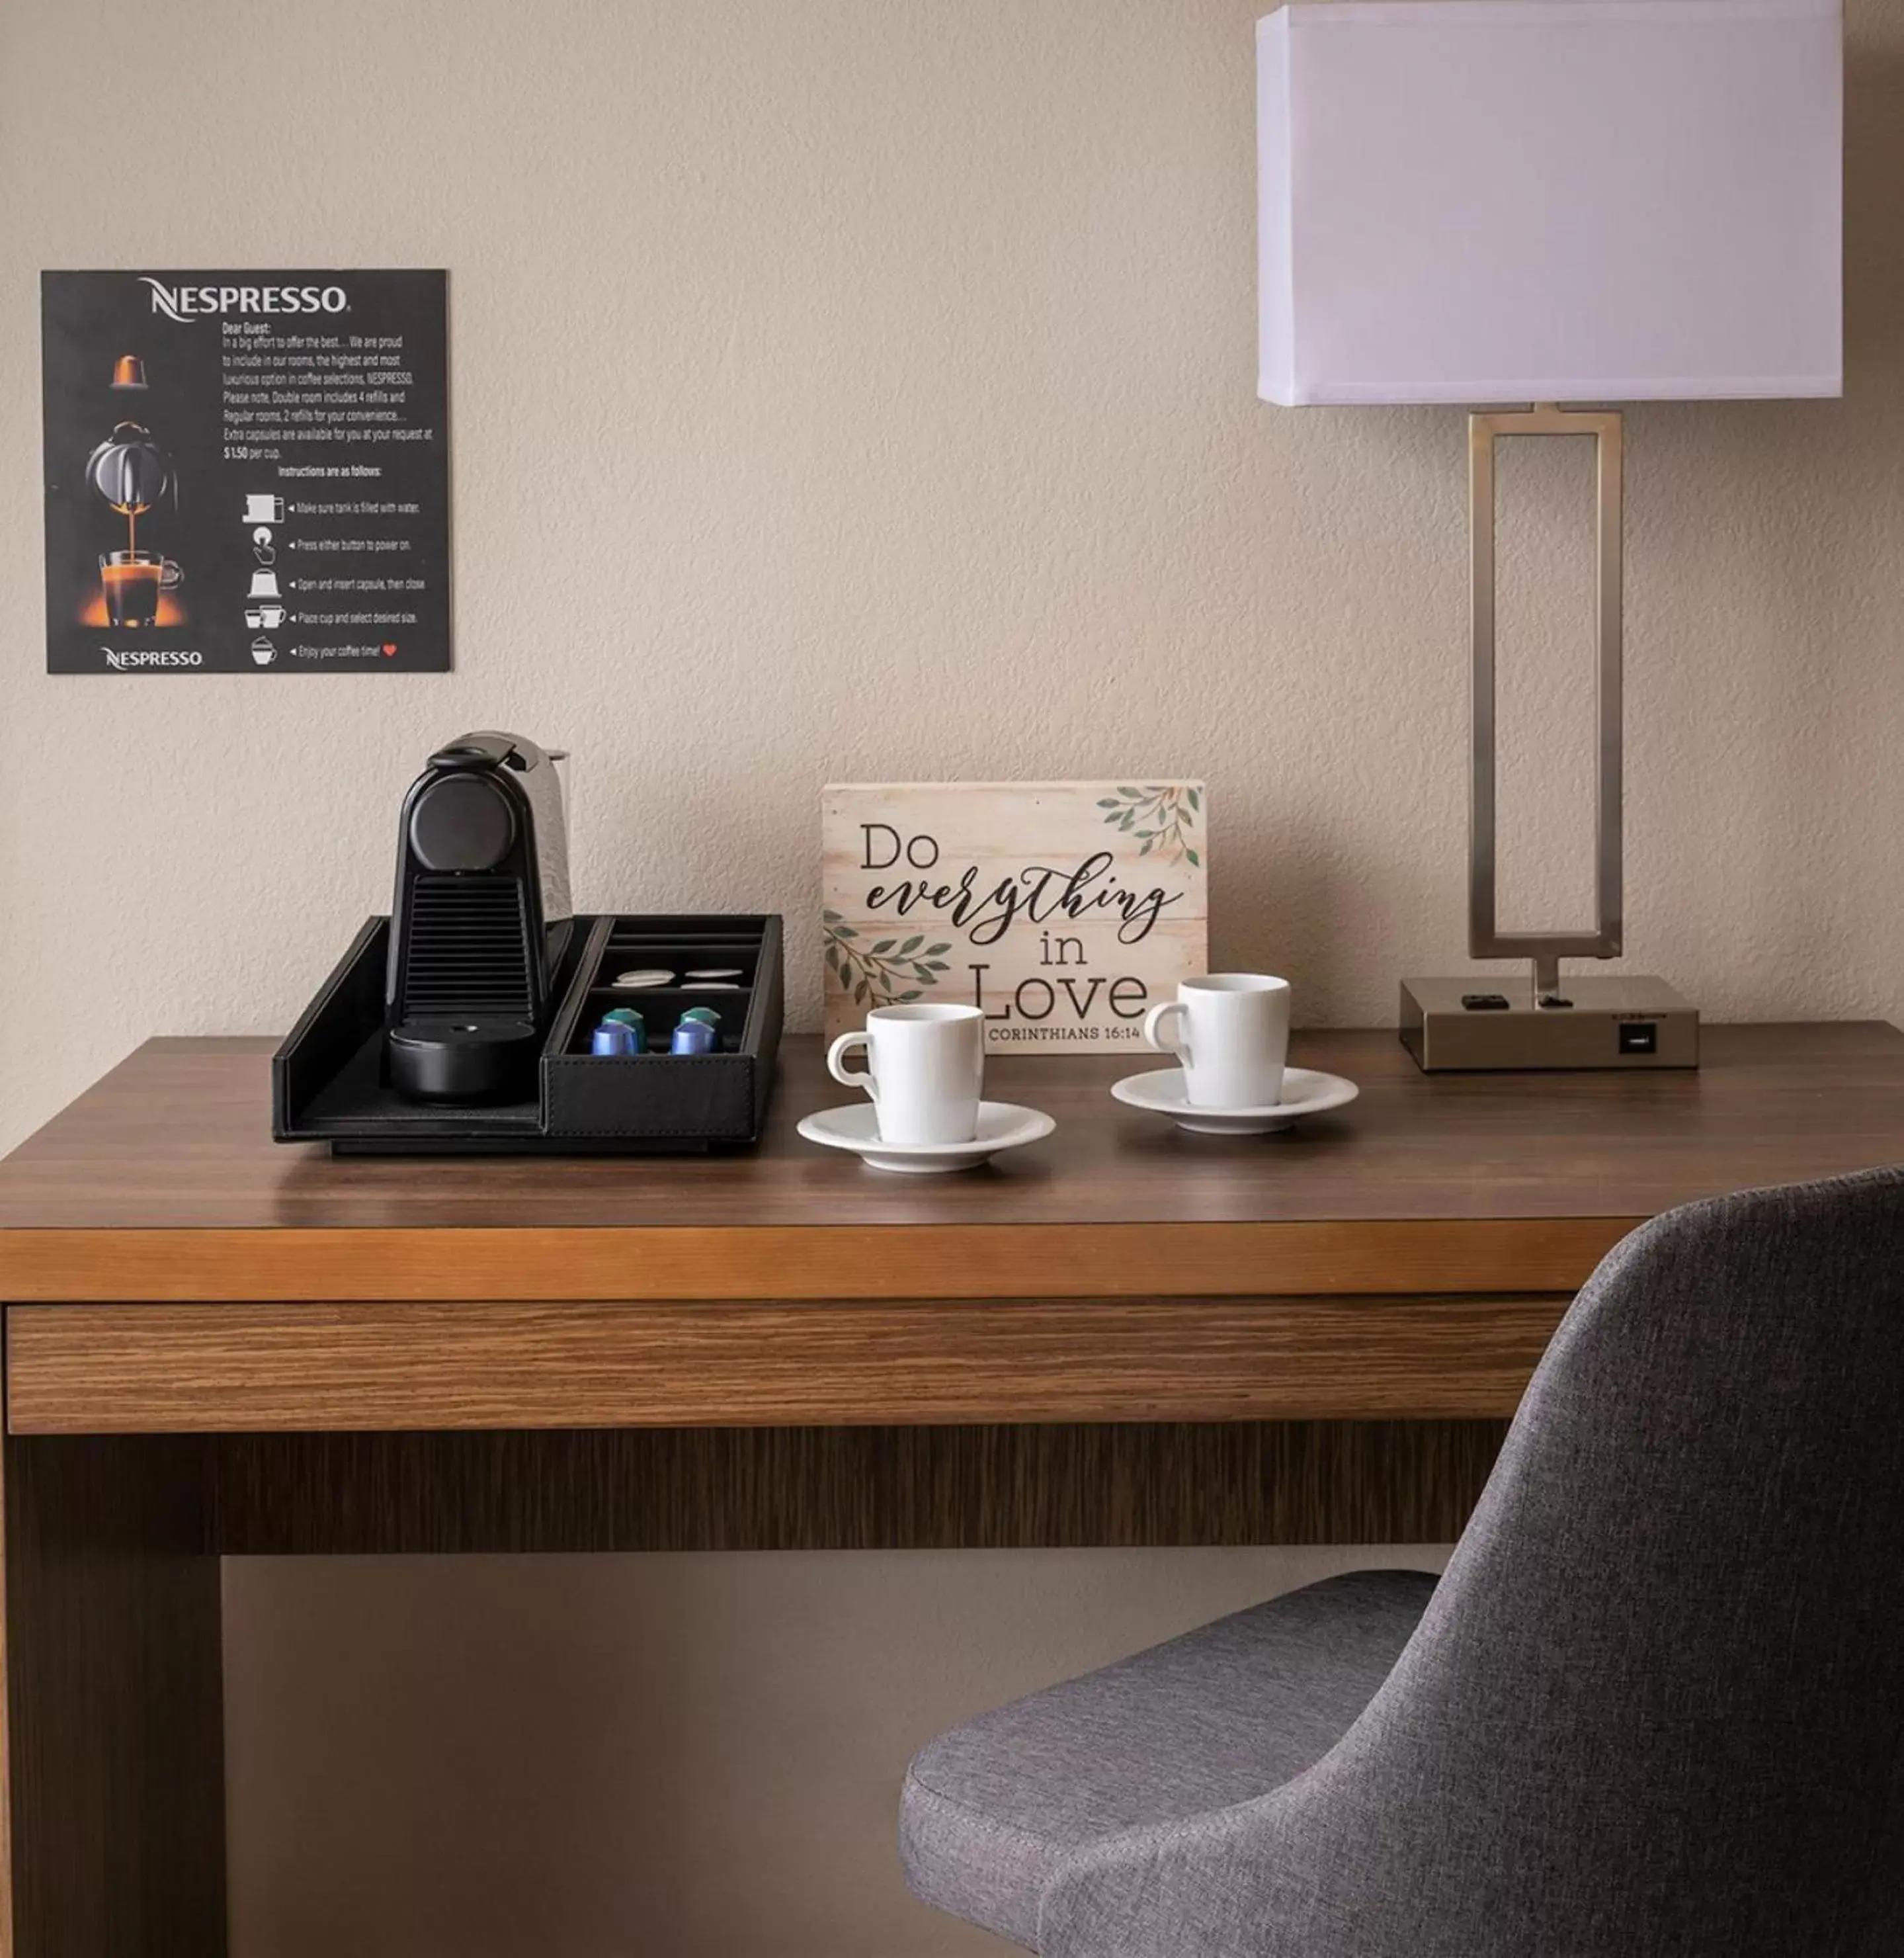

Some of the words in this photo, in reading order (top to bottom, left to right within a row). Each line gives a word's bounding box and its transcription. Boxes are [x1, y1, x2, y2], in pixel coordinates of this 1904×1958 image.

[138, 277, 347, 322] NESPRESSO
[223, 321, 242, 334] Dear
[222, 335, 231, 349] In
[232, 337, 238, 349] a
[239, 336, 252, 351] big
[253, 335, 275, 349] effort
[276, 337, 286, 349] to
[286, 335, 305, 349] offer
[306, 337, 319, 349] the
[349, 336, 363, 348] We
[364, 337, 378, 349] are
[378, 336, 403, 351] proud
[222, 355, 231, 366] to
[232, 355, 262, 366] include
[263, 355, 272, 366] in
[272, 356, 287, 366] our
[316, 355, 331, 366] the
[331, 355, 361, 368] highest
[362, 355, 379, 366] and
[380, 355, 401, 366] most
[223, 373, 259, 385] luxurious
[261, 373, 287, 386] option
[288, 372, 297, 385] in
[298, 372, 322, 385] coffee
[224, 391, 250, 404] Please
[272, 390, 300, 404] Double
[301, 392, 323, 404] room
[323, 390, 358, 404] includes
[358, 391, 365, 402] 4
[365, 390, 388, 404] refills
[390, 391, 405, 404] and
[223, 408, 254, 425] Regular
[283, 409, 290, 422] 2
[290, 408, 313, 422] refills
[314, 408, 327, 421] for
[327, 411, 345, 424] your
[224, 427, 245, 441] Extra
[245, 429, 282, 442] capsules
[282, 429, 296, 441] are
[296, 427, 333, 441] available
[333, 427, 345, 441] for
[346, 429, 362, 443] you
[363, 429, 372, 441] at
[372, 429, 392, 443] your
[392, 429, 423, 442] request
[423, 429, 433, 441] at
[249, 448, 263, 460] per
[278, 466, 325, 477] Instructions
[326, 466, 339, 477] are
[341, 466, 351, 477] as
[296, 502, 317, 513] Make
[318, 503, 335, 514] sure
[335, 502, 352, 513] tank
[353, 502, 360, 513] is
[360, 501, 379, 513] filled
[380, 502, 397, 513] with
[298, 538, 317, 550] Press
[318, 538, 340, 550] either
[341, 538, 366, 550] button
[366, 540, 374, 550] to
[375, 540, 399, 552] power
[298, 578, 317, 592] Open
[318, 579, 333, 590] and
[333, 579, 355, 590] insert
[387, 577, 405, 590] then
[298, 612, 318, 624] Place
[319, 614, 334, 626] cup
[335, 613, 350, 624] and
[350, 613, 373, 623] select
[373, 612, 401, 624] desired
[101, 647, 202, 670] NESPRESSO
[298, 644, 319, 659] Enjoy
[319, 647, 337, 659] your
[337, 644, 360, 658] coffee
[860, 824, 939, 870] Do
[866, 851, 1185, 946] everything
[1040, 931, 1088, 965] in
[968, 964, 1147, 1021] Love
[988, 1027, 1100, 1041] CORINTHIANS
[1105, 1027, 1140, 1040] 16:14
